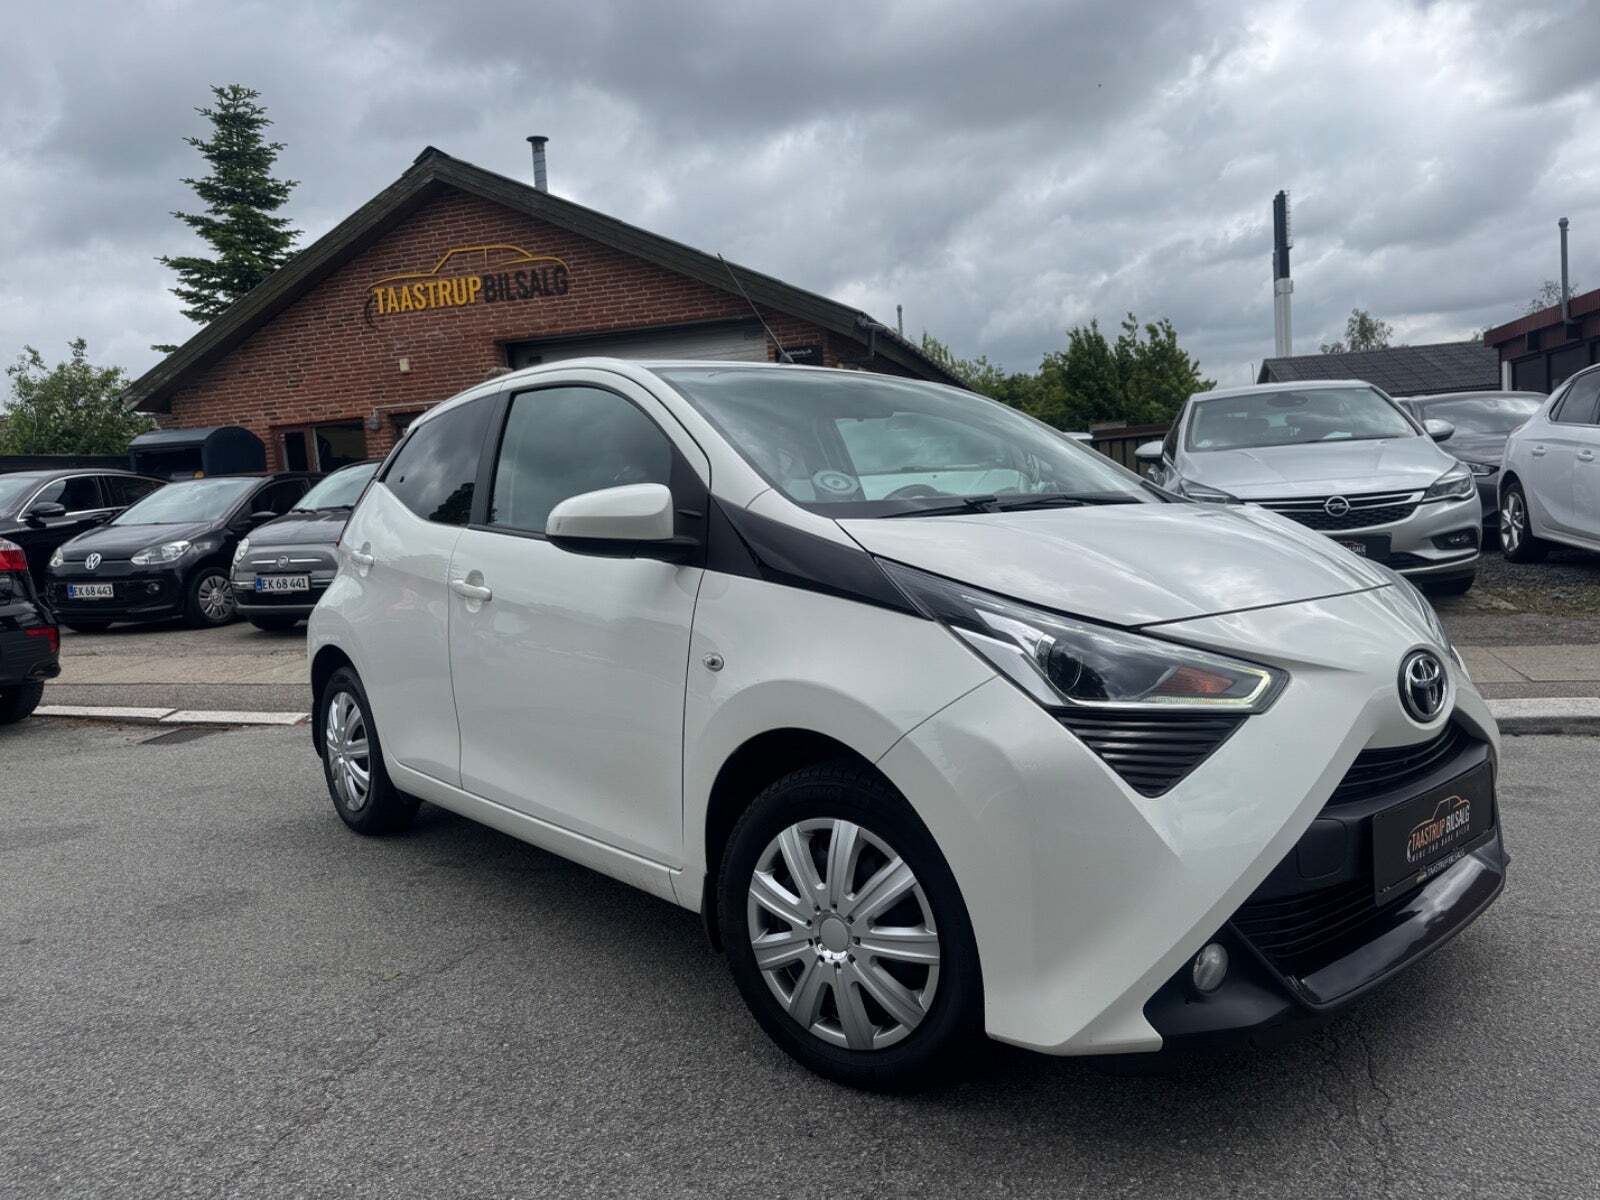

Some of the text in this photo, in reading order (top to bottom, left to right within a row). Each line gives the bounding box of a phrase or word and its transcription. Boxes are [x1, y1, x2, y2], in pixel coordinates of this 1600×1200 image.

[262, 577, 306, 590] EK 68 441
[73, 586, 84, 597] EK
[85, 586, 96, 596] 68
